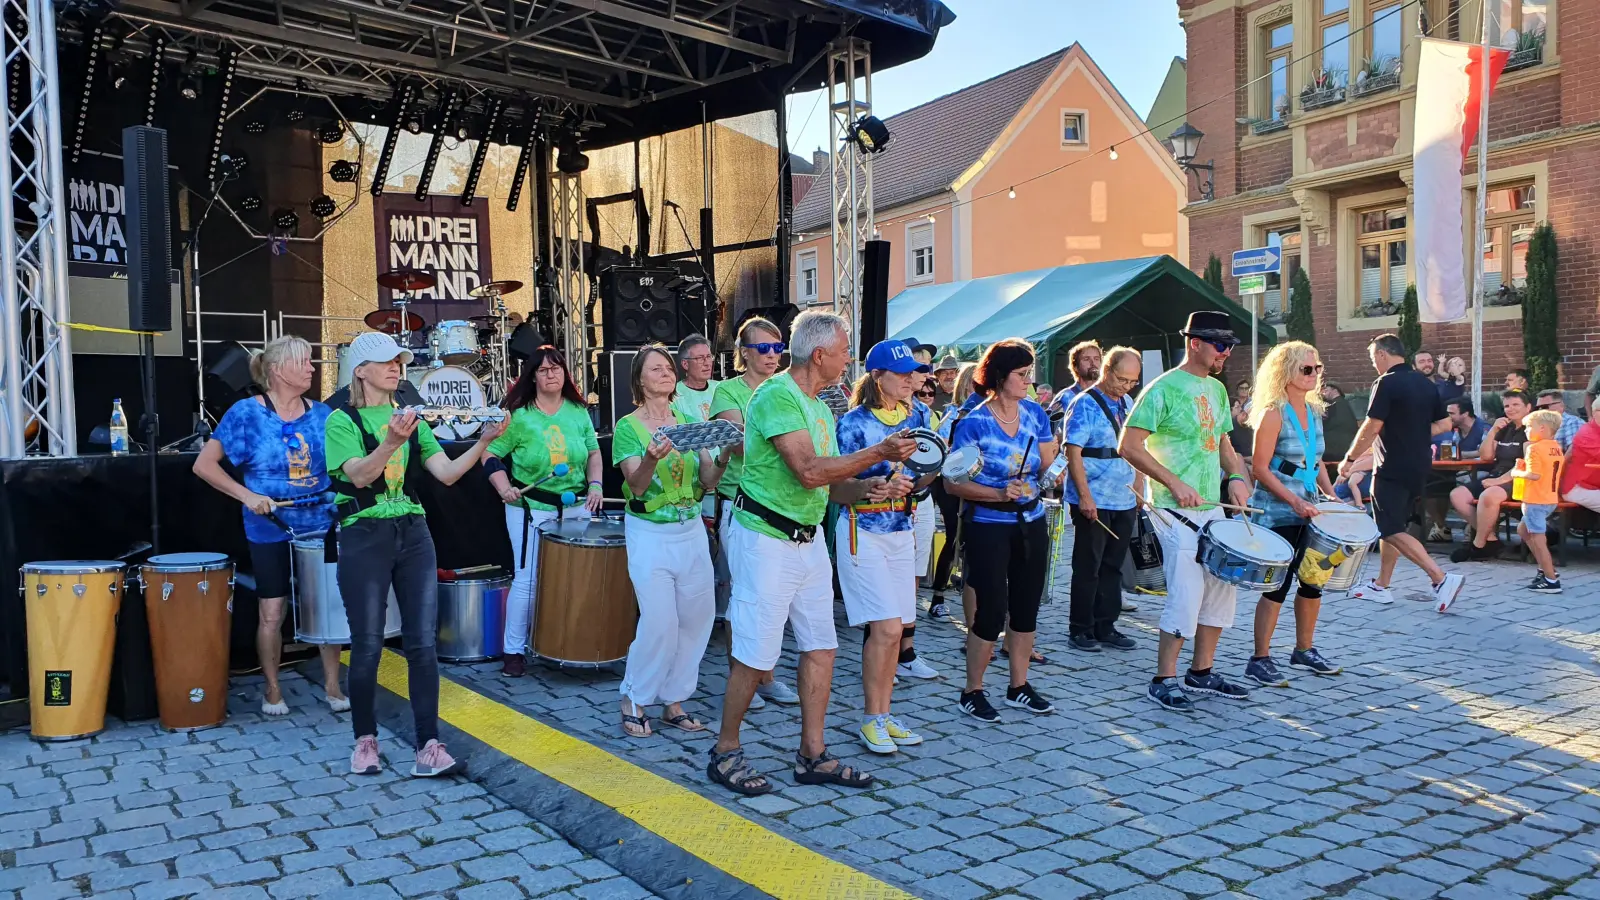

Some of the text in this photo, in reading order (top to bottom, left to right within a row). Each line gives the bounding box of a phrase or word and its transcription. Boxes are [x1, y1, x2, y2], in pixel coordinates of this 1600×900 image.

[416, 215, 478, 244] DREI
[390, 242, 479, 270] MANN
[427, 394, 472, 407] MANN
[440, 380, 472, 394] DREI
[1551, 460, 1560, 493] 1
